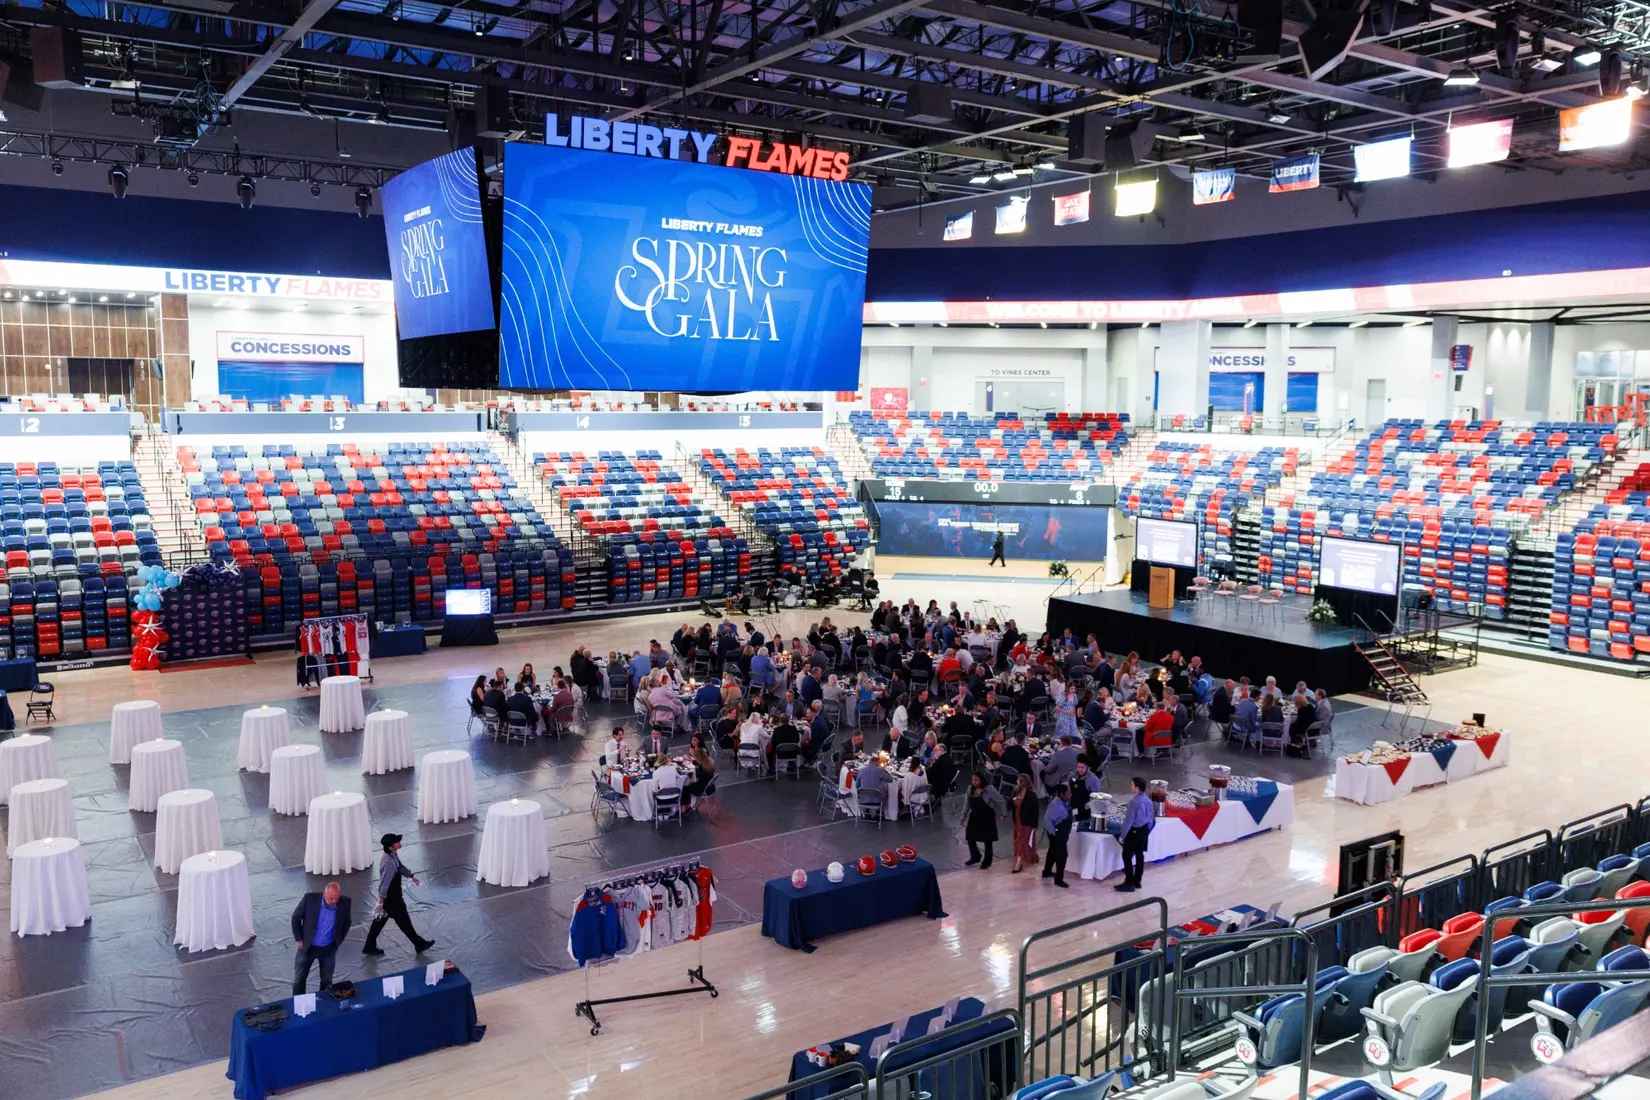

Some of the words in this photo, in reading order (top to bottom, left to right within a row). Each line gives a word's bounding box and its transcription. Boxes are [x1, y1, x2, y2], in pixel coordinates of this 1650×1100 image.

[546, 112, 718, 163] LIBERTY
[726, 135, 850, 182] FLAMES
[1275, 163, 1315, 178] LIBERTY
[661, 217, 714, 233] LIBERTY
[715, 222, 764, 238] FLAMES
[401, 218, 445, 283] SPRING
[408, 255, 450, 299] GALA
[614, 236, 788, 311] SPRING
[165, 271, 281, 294] LIBERTY
[286, 278, 382, 299] FLAMES
[645, 280, 781, 342] GALA
[230, 341, 352, 357] CONCESSIONS
[1024, 369, 1051, 377] CENTER
[25, 417, 41, 433] 2
[333, 416, 346, 431] 3
[973, 482, 999, 493] 00.0
